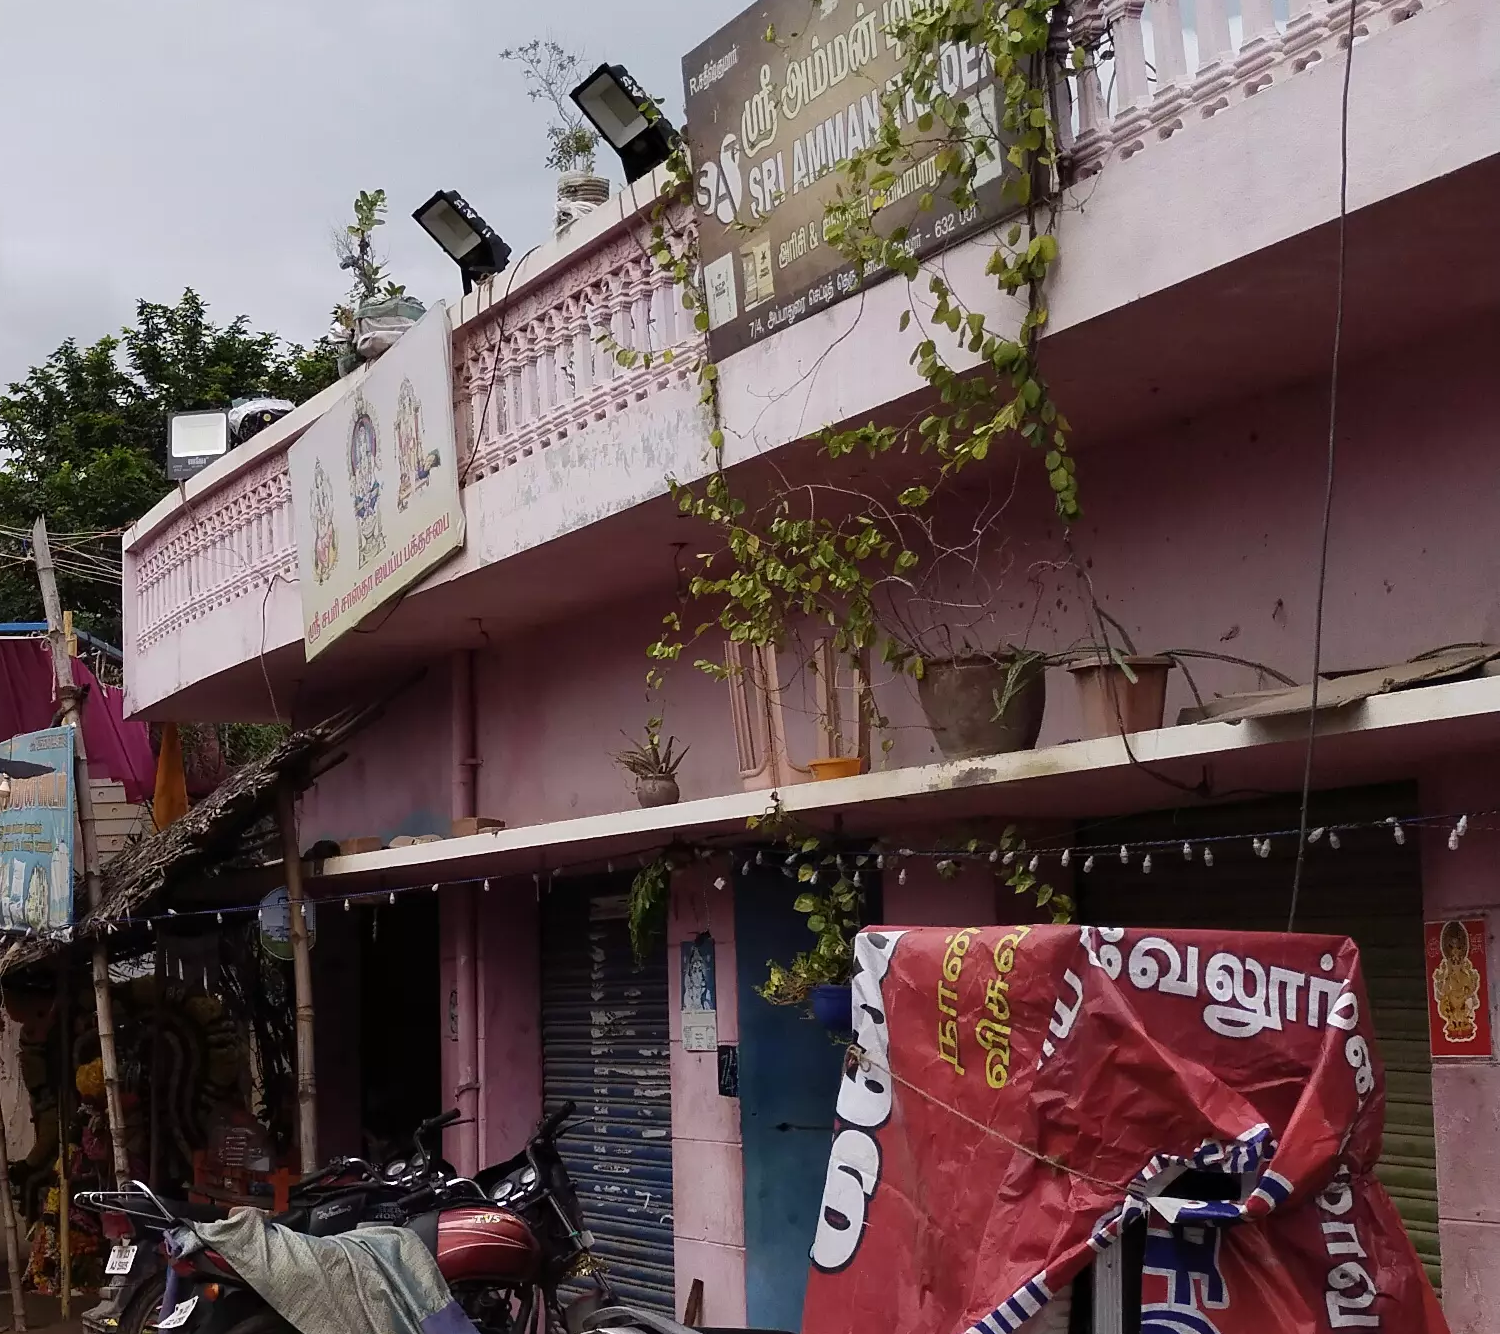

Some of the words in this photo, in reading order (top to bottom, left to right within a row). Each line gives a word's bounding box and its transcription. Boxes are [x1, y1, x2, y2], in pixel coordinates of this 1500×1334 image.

[780, 2, 878, 120] அம்மன்
[749, 151, 786, 218] SRI
[792, 88, 881, 197] AMMAN
[778, 229, 807, 269] அரிசி
[808, 220, 819, 250] &
[934, 213, 955, 238] 632
[321, 597, 340, 628] சபரி
[374, 551, 403, 586] ஐயப்ப
[473, 1213, 501, 1224] TVS
